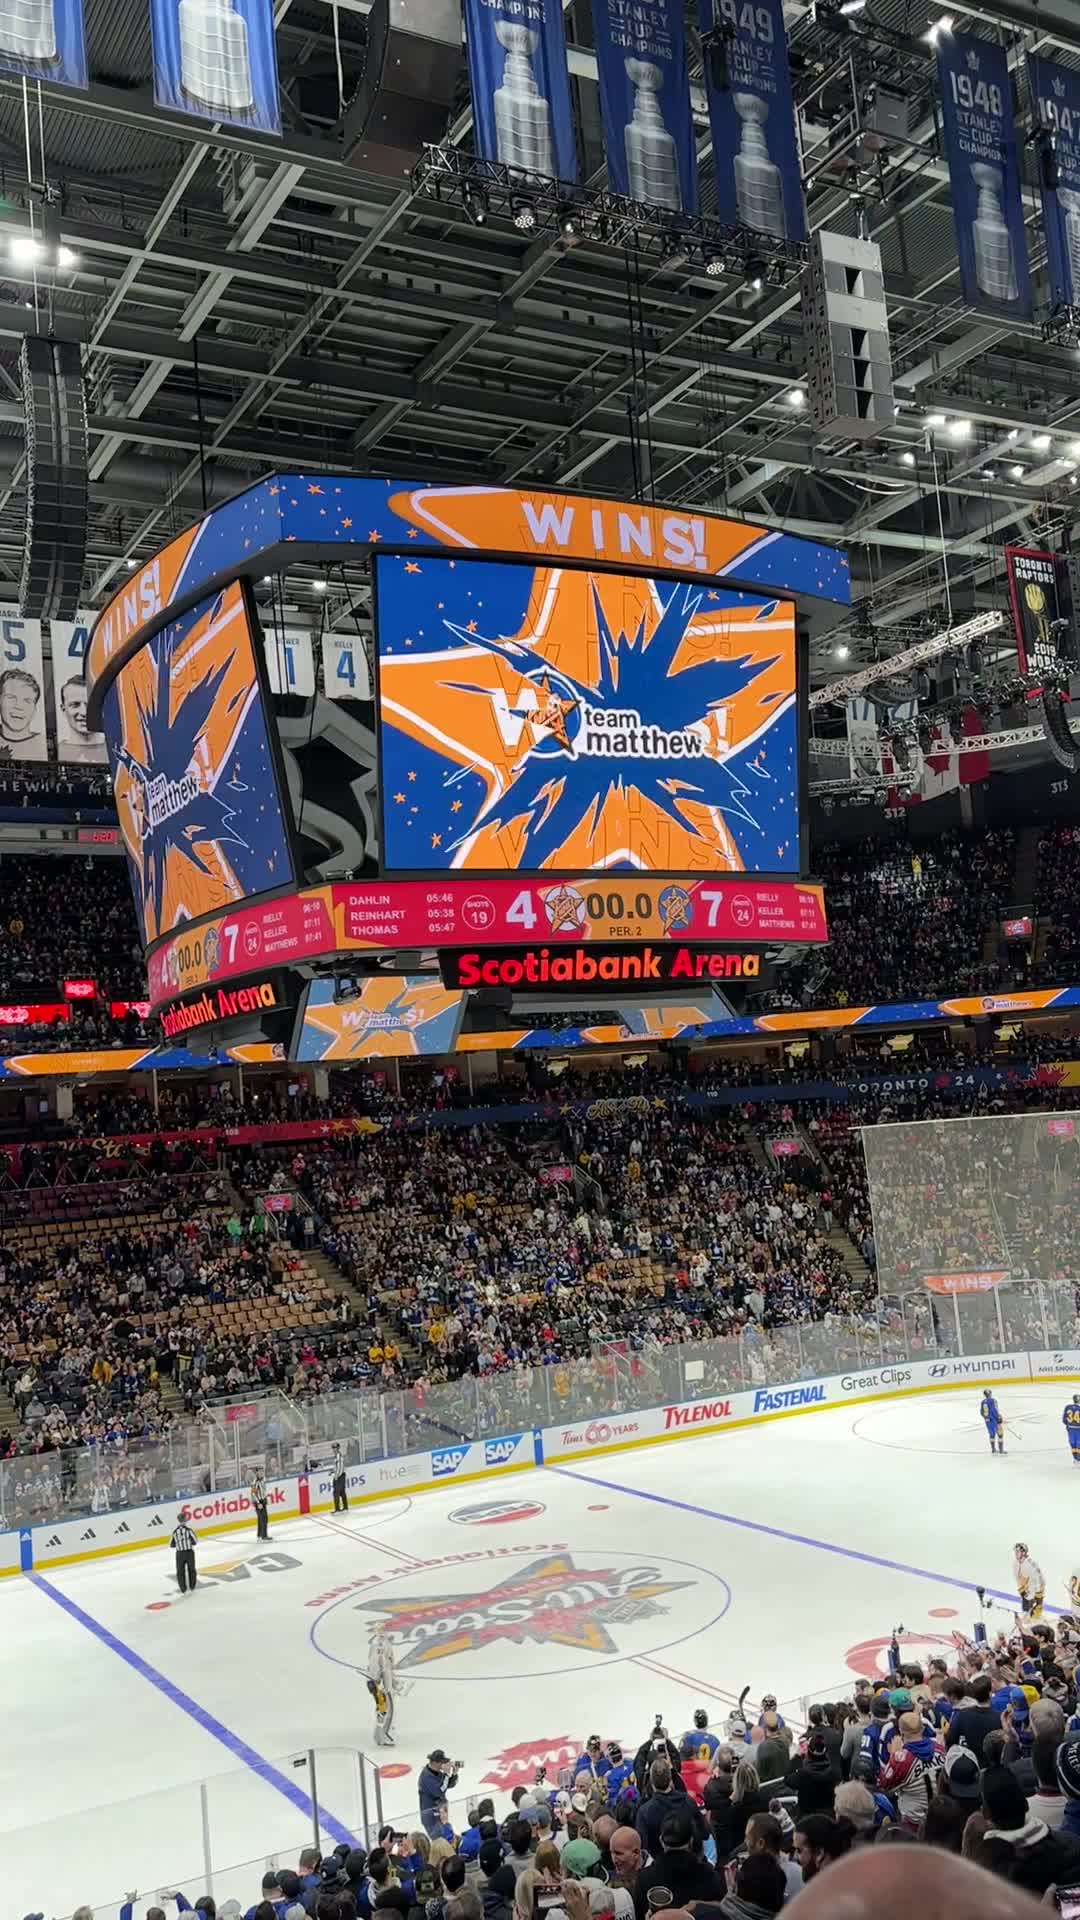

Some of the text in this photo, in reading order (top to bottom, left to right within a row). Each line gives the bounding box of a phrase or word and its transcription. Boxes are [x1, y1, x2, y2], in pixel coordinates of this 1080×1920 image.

[950, 71, 1002, 117] 1948
[972, 128, 993, 145] CUP
[520, 501, 708, 570] WINS!
[1014, 557, 1053, 573] TORONTO
[1015, 568, 1054, 584] RAPTORS
[103, 560, 160, 657] WINS!
[3, 620, 26, 662] 5
[1034, 642, 1056, 657] 2019
[336, 650, 357, 688] 4
[585, 708, 638, 729] team
[349, 893, 453, 906] DAHLIN 05:46
[506, 890, 537, 929] 4
[586, 893, 652, 919] 00.0
[701, 891, 723, 926] 7
[350, 910, 405, 921] REINHART
[471, 911, 487, 924] 19
[737, 909, 749, 921] 24
[758, 907, 784, 915] KELLER
[352, 923, 455, 935] THOMAS 05:47
[636, 927, 642, 936] 2
[224, 924, 239, 963] 7
[179, 941, 201, 972] 00.0
[459, 948, 760, 985] Scotiabank Arena
[160, 982, 277, 1037] Scotiabank Arena
[850, 1075, 975, 1093] TORONTO 24
[953, 1359, 1016, 1375] HYUNDAI
[841, 1368, 912, 1391] Great Clips
[753, 1385, 827, 1412] FASTENAL
[663, 1401, 731, 1429] TYLENOL
[612, 1422, 639, 1436] YEARS
[485, 1438, 516, 1461] SAP
[433, 1451, 464, 1473] SAP
[319, 1474, 366, 1494] PHIPS
[181, 1487, 286, 1520] Scotiabnk
[304, 1543, 568, 1607] Scotiabank Arena
[861, 1735, 871, 1748] 91
